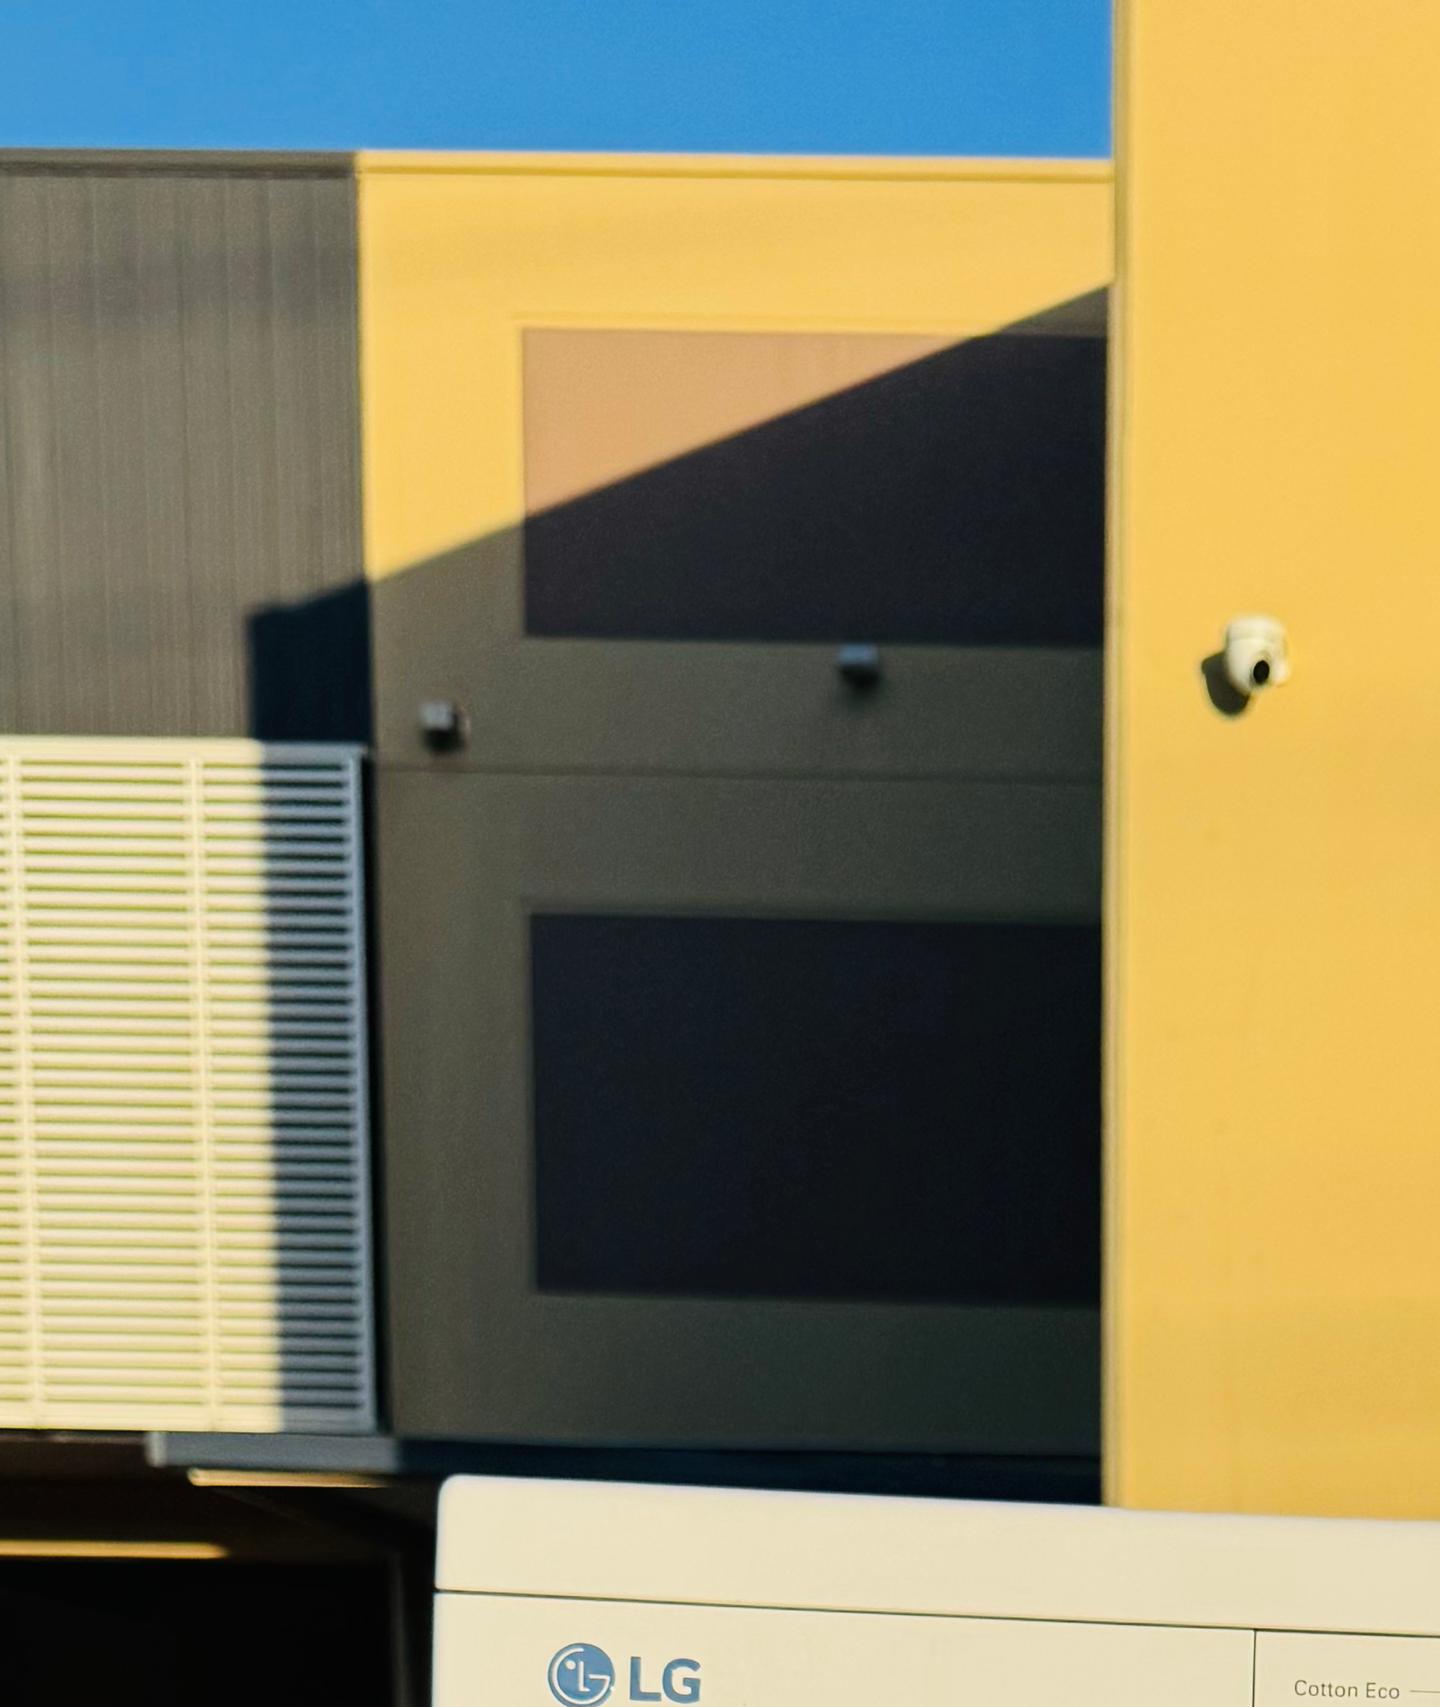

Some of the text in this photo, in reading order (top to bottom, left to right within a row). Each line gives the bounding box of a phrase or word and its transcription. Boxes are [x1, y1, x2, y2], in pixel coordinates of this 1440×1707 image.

[629, 1656, 701, 1703] LG
[1294, 1679, 1400, 1700] Cotton Eco
